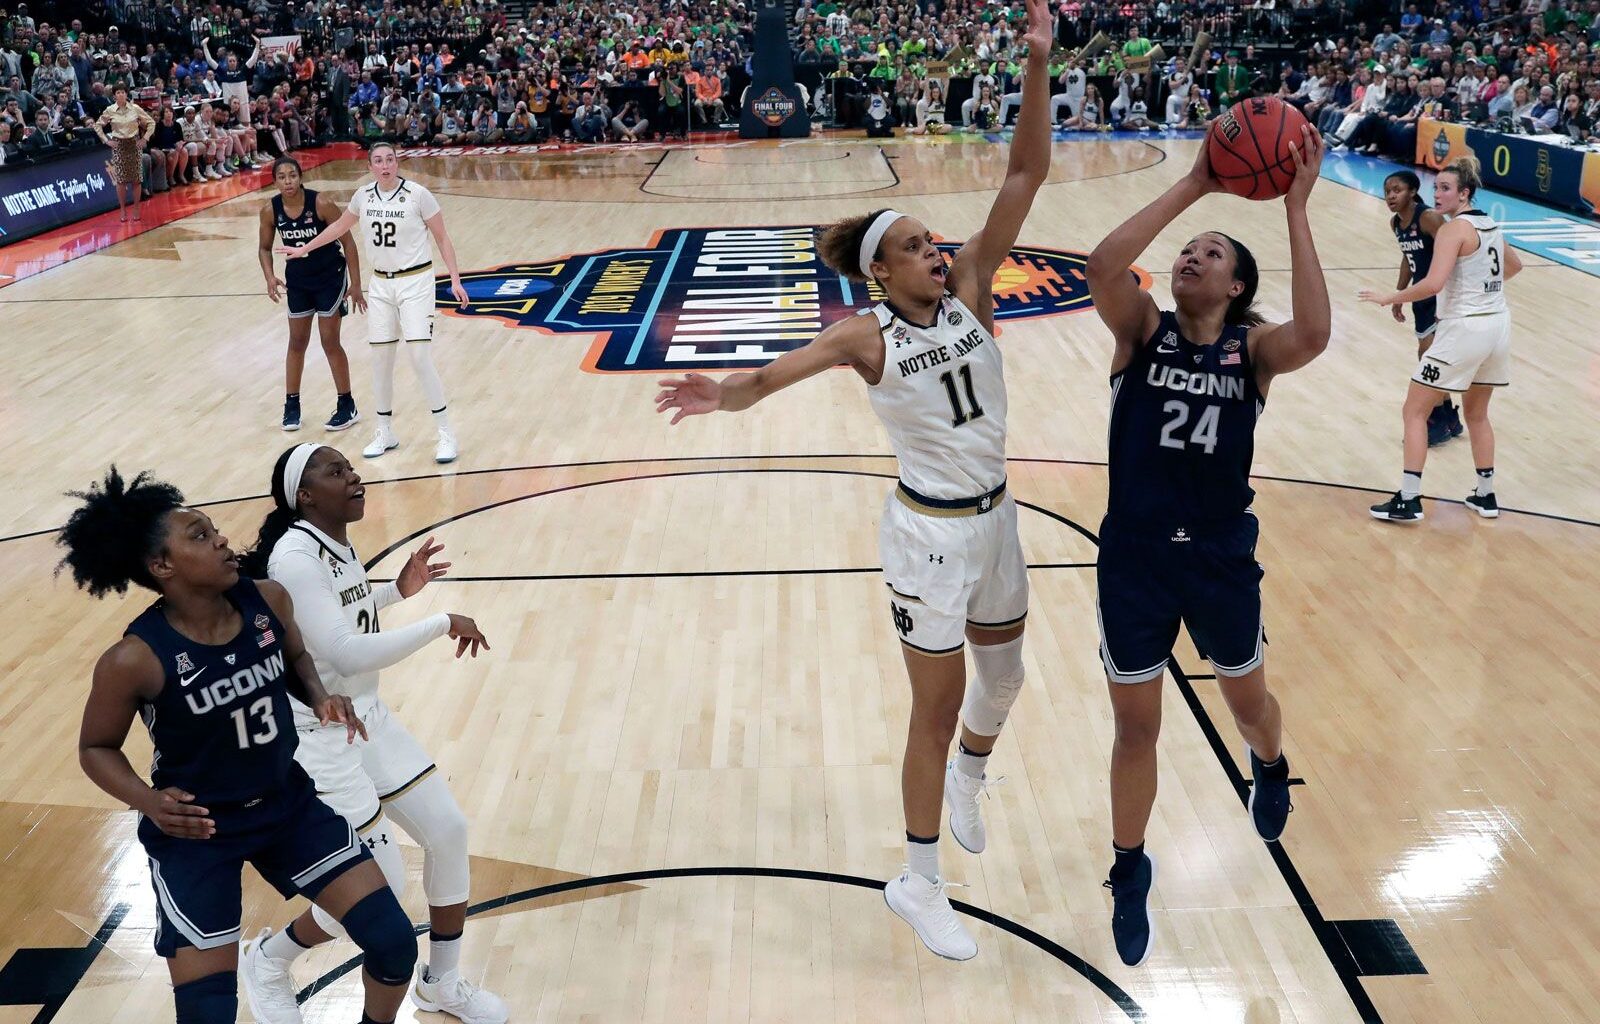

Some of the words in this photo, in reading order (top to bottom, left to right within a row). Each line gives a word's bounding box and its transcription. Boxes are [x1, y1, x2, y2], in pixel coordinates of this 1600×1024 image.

[754, 102, 773, 110] FINAL
[775, 102, 793, 110] FOUR
[2, 190, 37, 216] NOTRE
[31, 184, 60, 208] DAME
[56, 179, 90, 203] Fighting
[366, 209, 383, 217] NOTRE
[280, 227, 317, 239] UCONN
[371, 221, 396, 247] 32
[692, 228, 816, 277] FOUR
[1406, 253, 1416, 273] 5
[1488, 246, 1500, 276] 3
[578, 295, 636, 314] 2019
[665, 282, 821, 362] FINAL
[897, 345, 951, 378] NOTRE
[939, 362, 985, 428] 11
[1146, 363, 1245, 400] UCONN
[1159, 399, 1221, 454] 24
[339, 583, 366, 607] NOTRE
[185, 650, 285, 714] UCONN
[230, 696, 279, 749] 13
